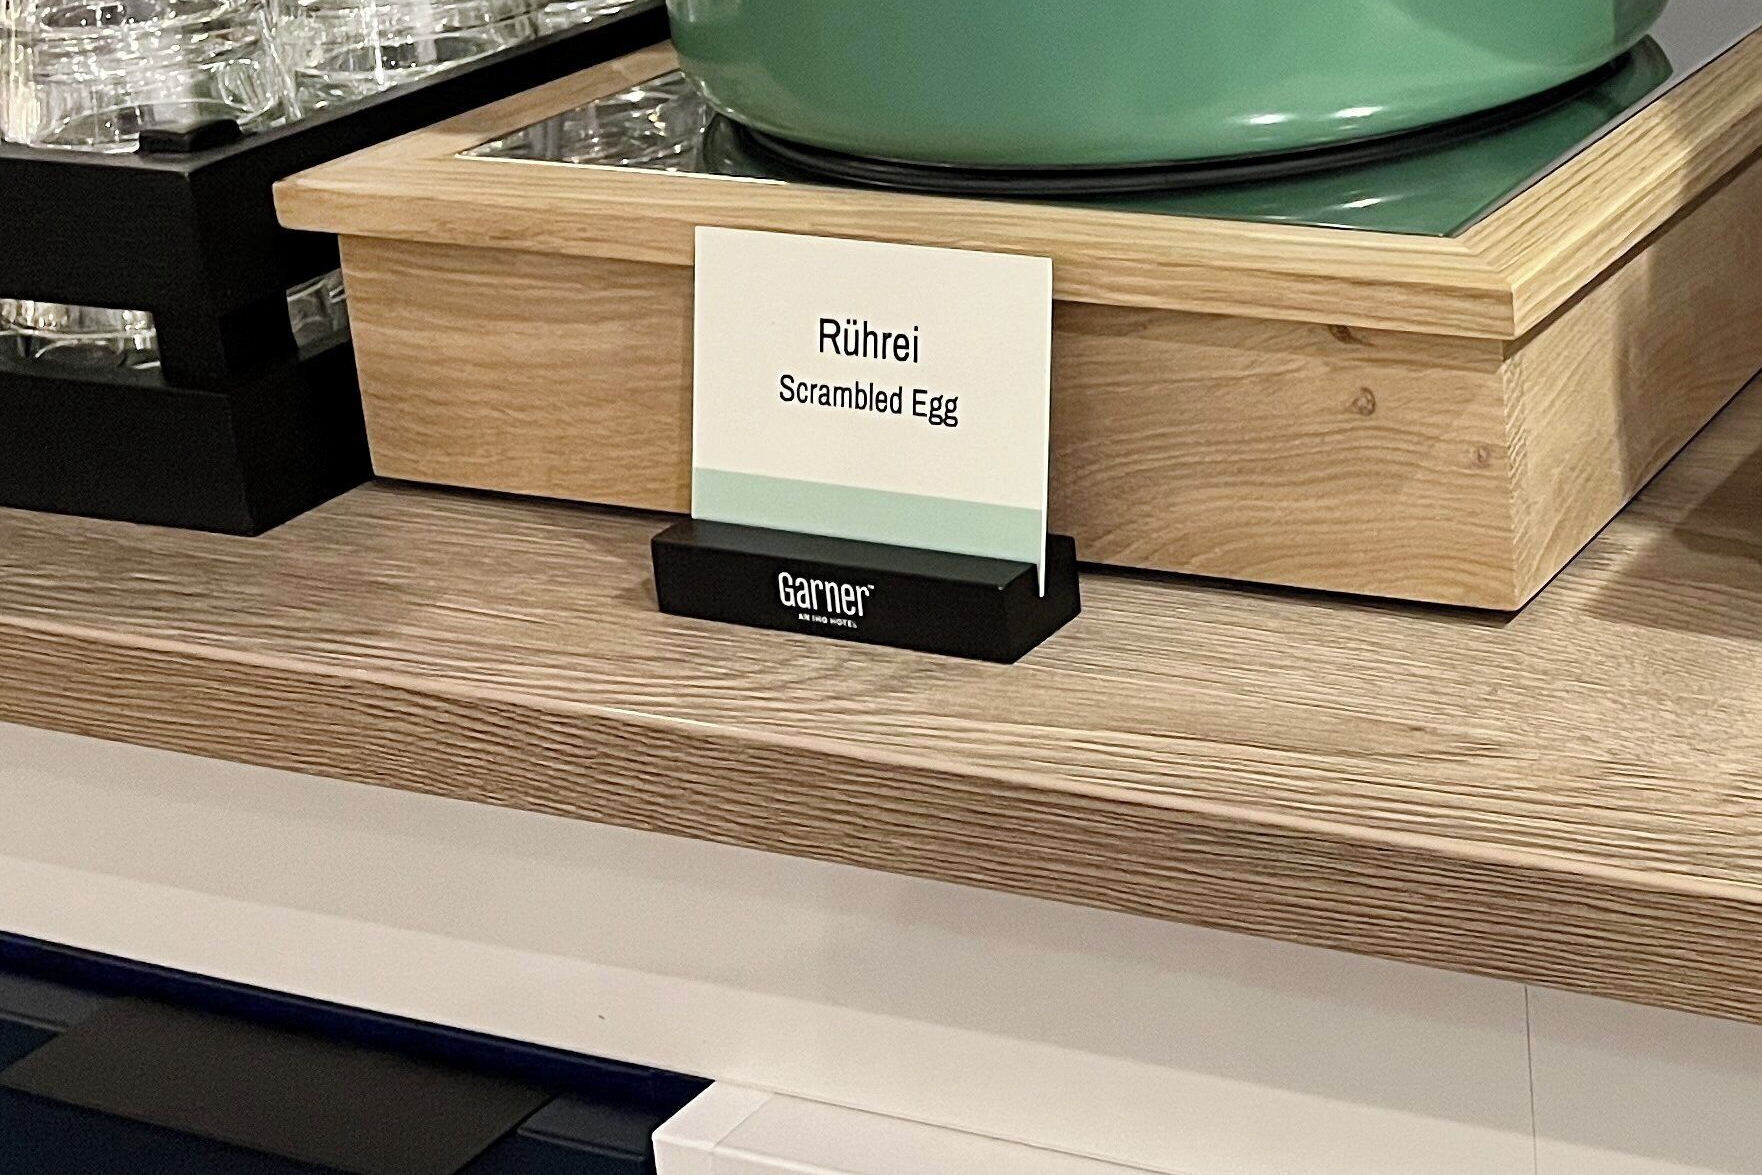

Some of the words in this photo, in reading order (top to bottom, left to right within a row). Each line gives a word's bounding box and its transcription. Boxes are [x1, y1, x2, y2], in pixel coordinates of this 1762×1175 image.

[819, 317, 919, 363] Rührei
[779, 374, 903, 415] Scrambled
[912, 388, 959, 428] Egg
